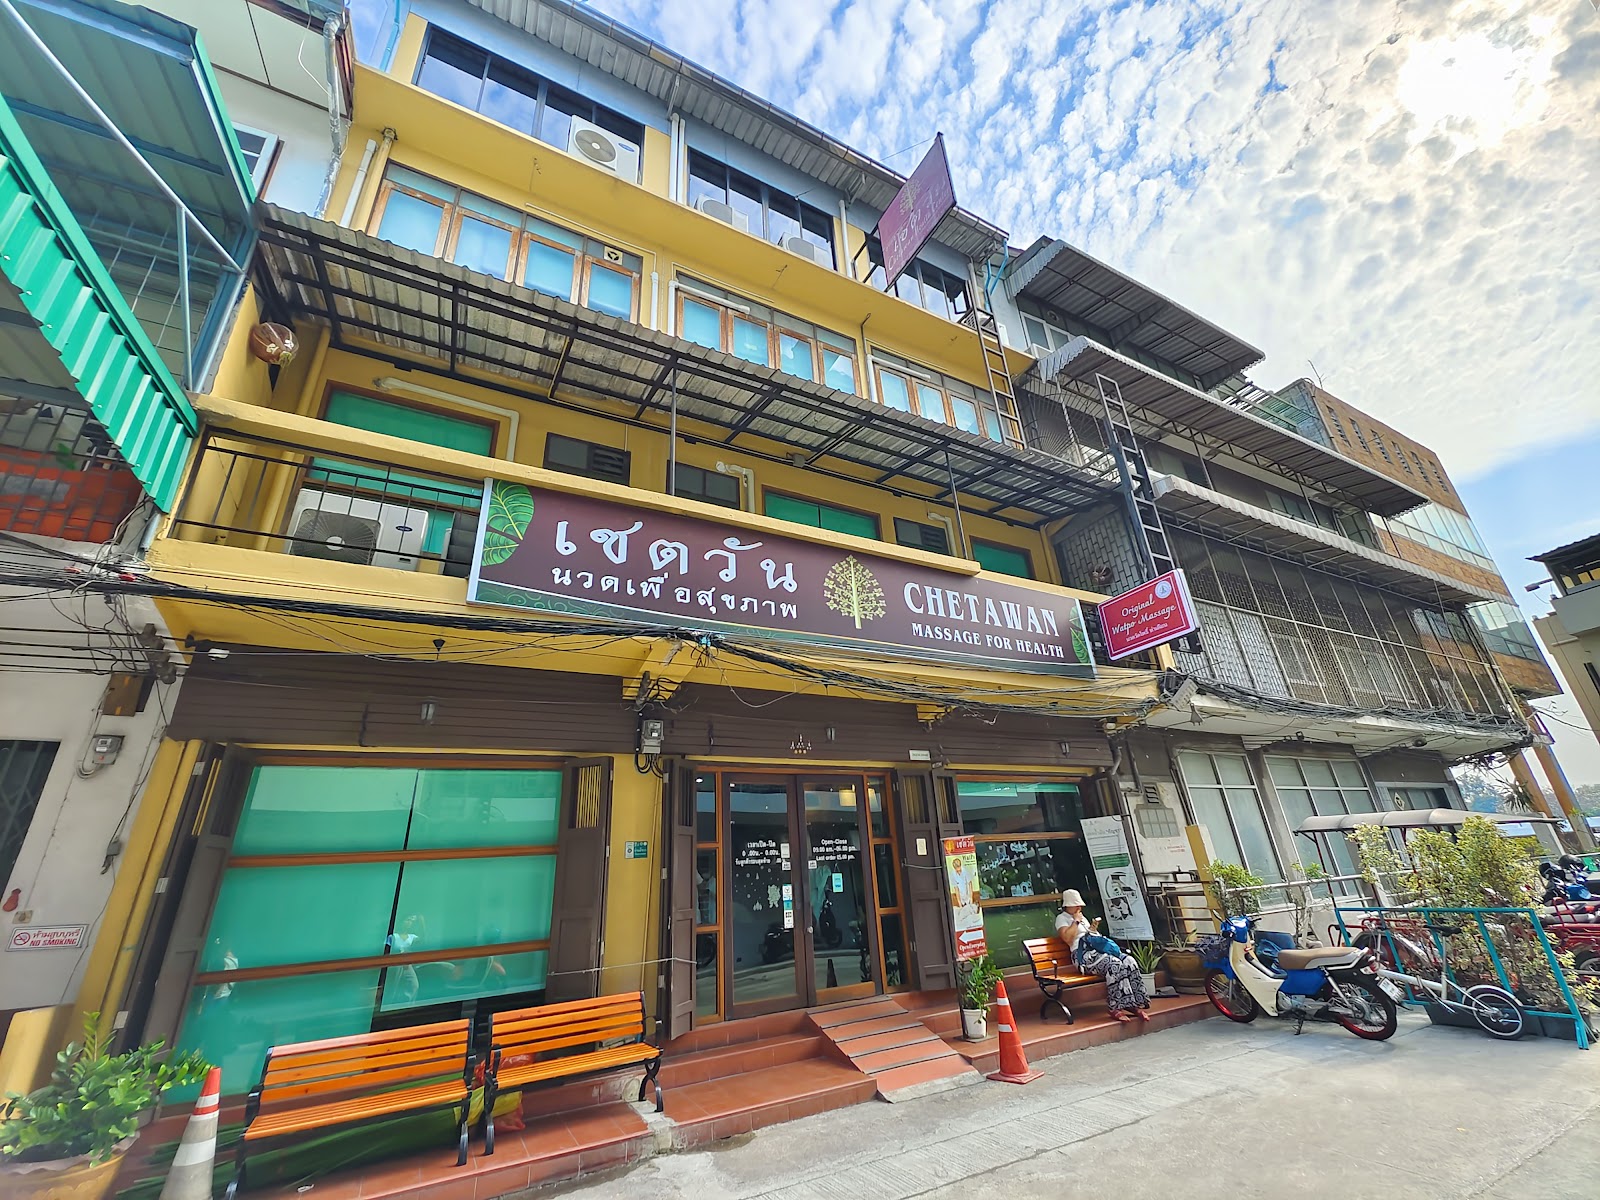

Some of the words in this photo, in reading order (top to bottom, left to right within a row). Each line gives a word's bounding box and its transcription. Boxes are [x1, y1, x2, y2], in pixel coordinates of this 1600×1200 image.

[555, 520, 798, 594] เชตวัน
[551, 566, 798, 619] นวดเพื่อสุขภาพ
[903, 582, 1060, 637] CHETAWAN
[1121, 593, 1155, 618] Original
[1111, 621, 1137, 636] Watpo
[1138, 604, 1177, 626] Massage
[911, 622, 982, 646] MASSAGE
[985, 634, 1013, 650] FOR
[1015, 639, 1065, 658] HEALTH
[42, 938, 77, 946] SMOKING
